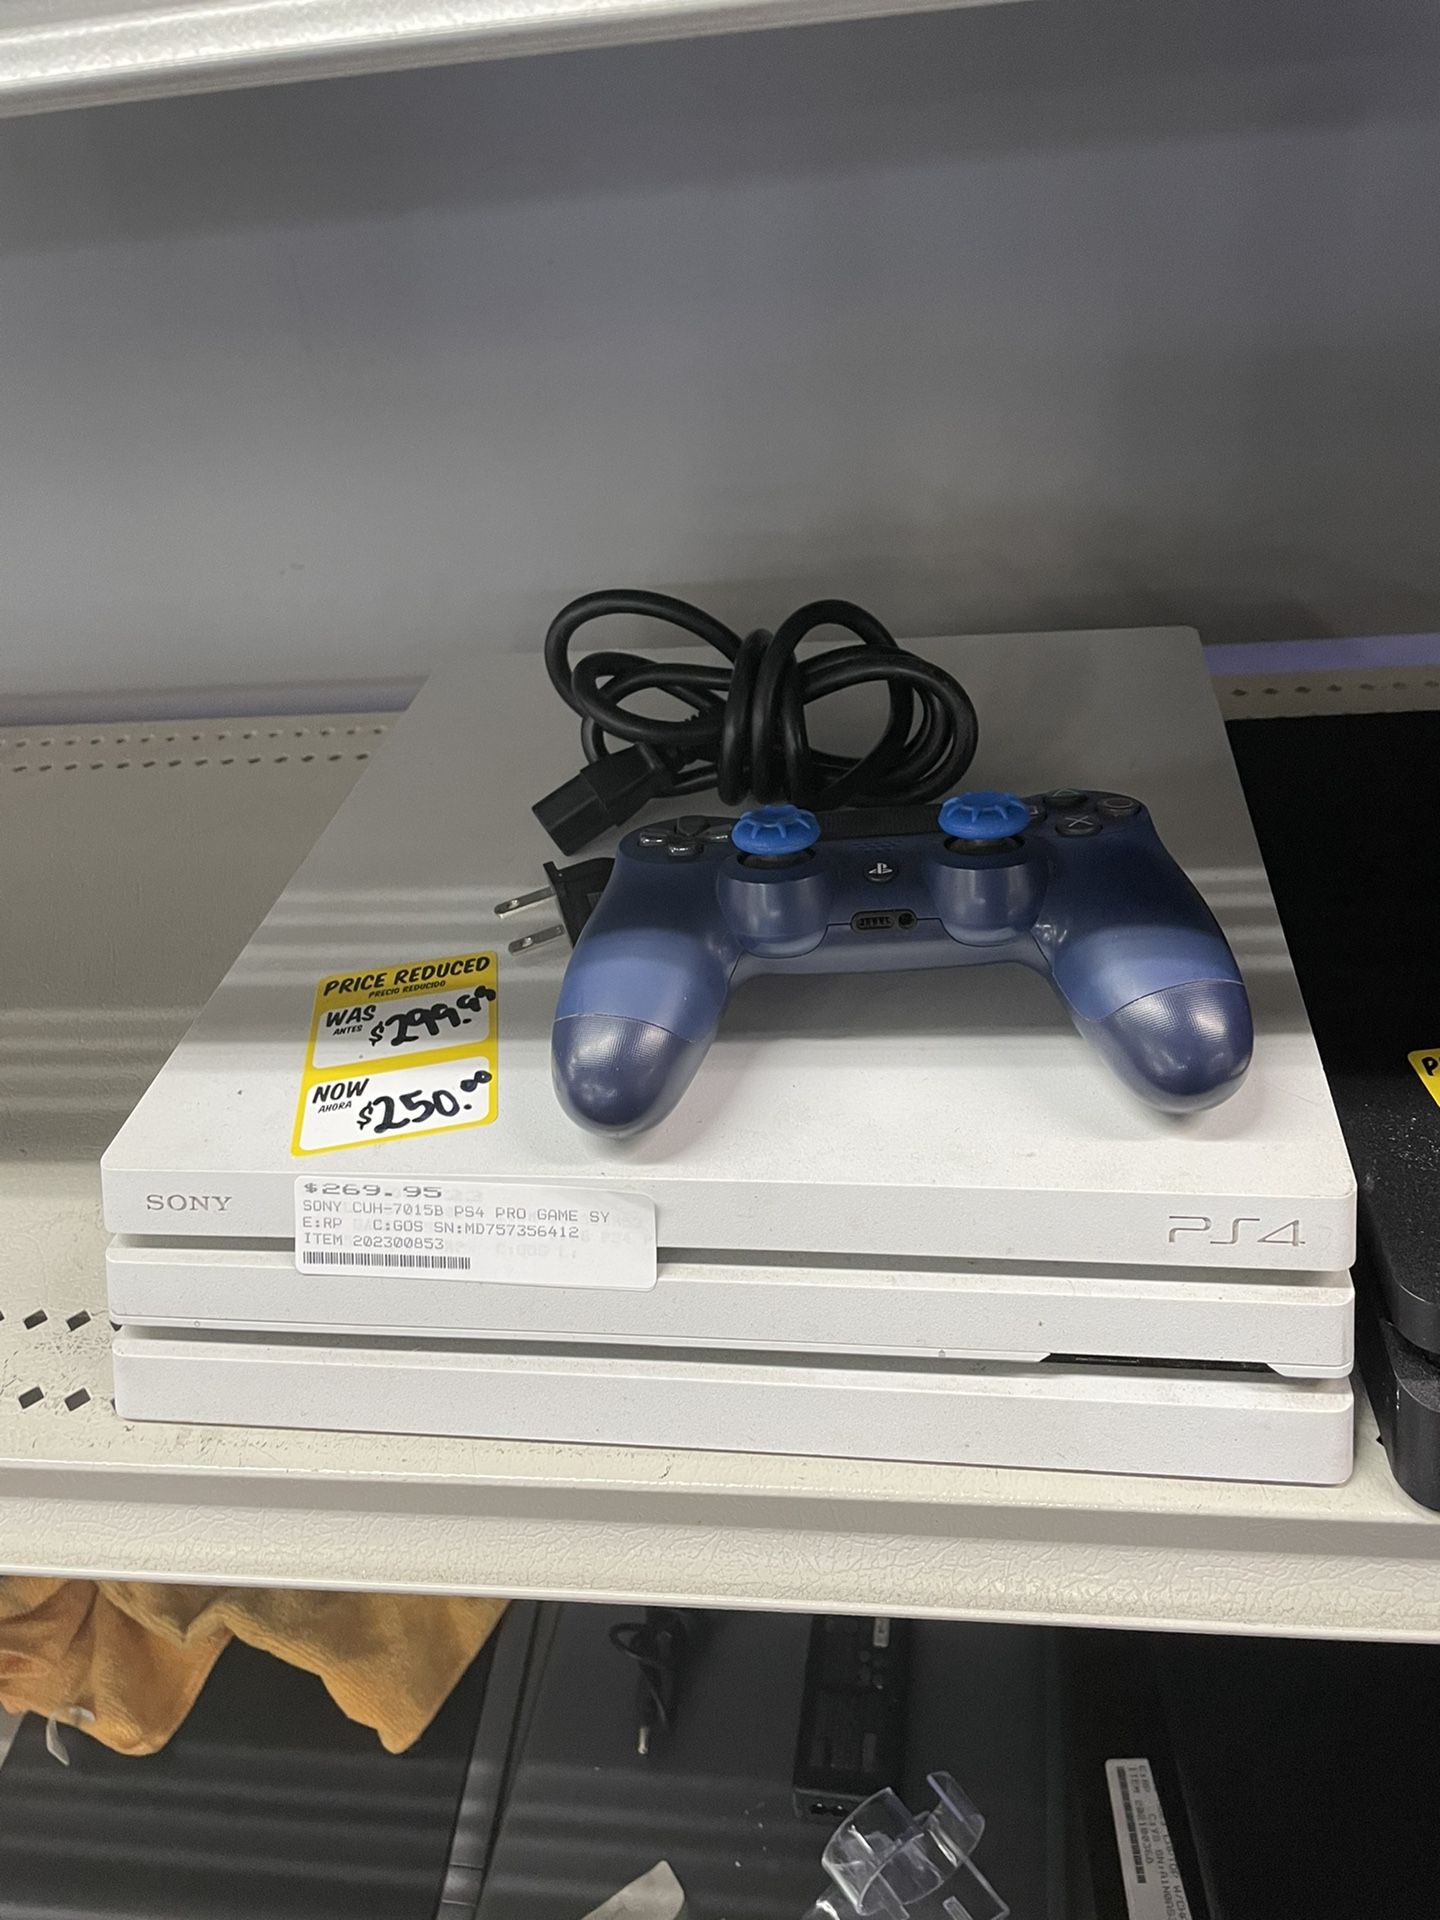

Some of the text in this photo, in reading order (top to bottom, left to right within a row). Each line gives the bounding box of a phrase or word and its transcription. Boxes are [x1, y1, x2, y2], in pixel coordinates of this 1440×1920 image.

[323, 956, 490, 996] PRICE REDUCED
[368, 980, 446, 999] PRECIO REDUCIDO
[326, 1004, 377, 1028] WAS
[332, 1024, 363, 1036] ANTES
[1421, 1056, 1440, 1076] P
[312, 1078, 370, 1104] NOW
[317, 1100, 352, 1114] AHORA
[303, 1182, 442, 1198] $269.95
[146, 1194, 232, 1211] SONY
[303, 1200, 610, 1223] SONY CUH-7015B PS4 PRO GAME SY
[302, 1216, 342, 1229] E:RP
[434, 1222, 579, 1239] SN:MD757356412
[1169, 1215, 1306, 1247] PS4
[304, 1232, 444, 1250] ITEM 202300853
